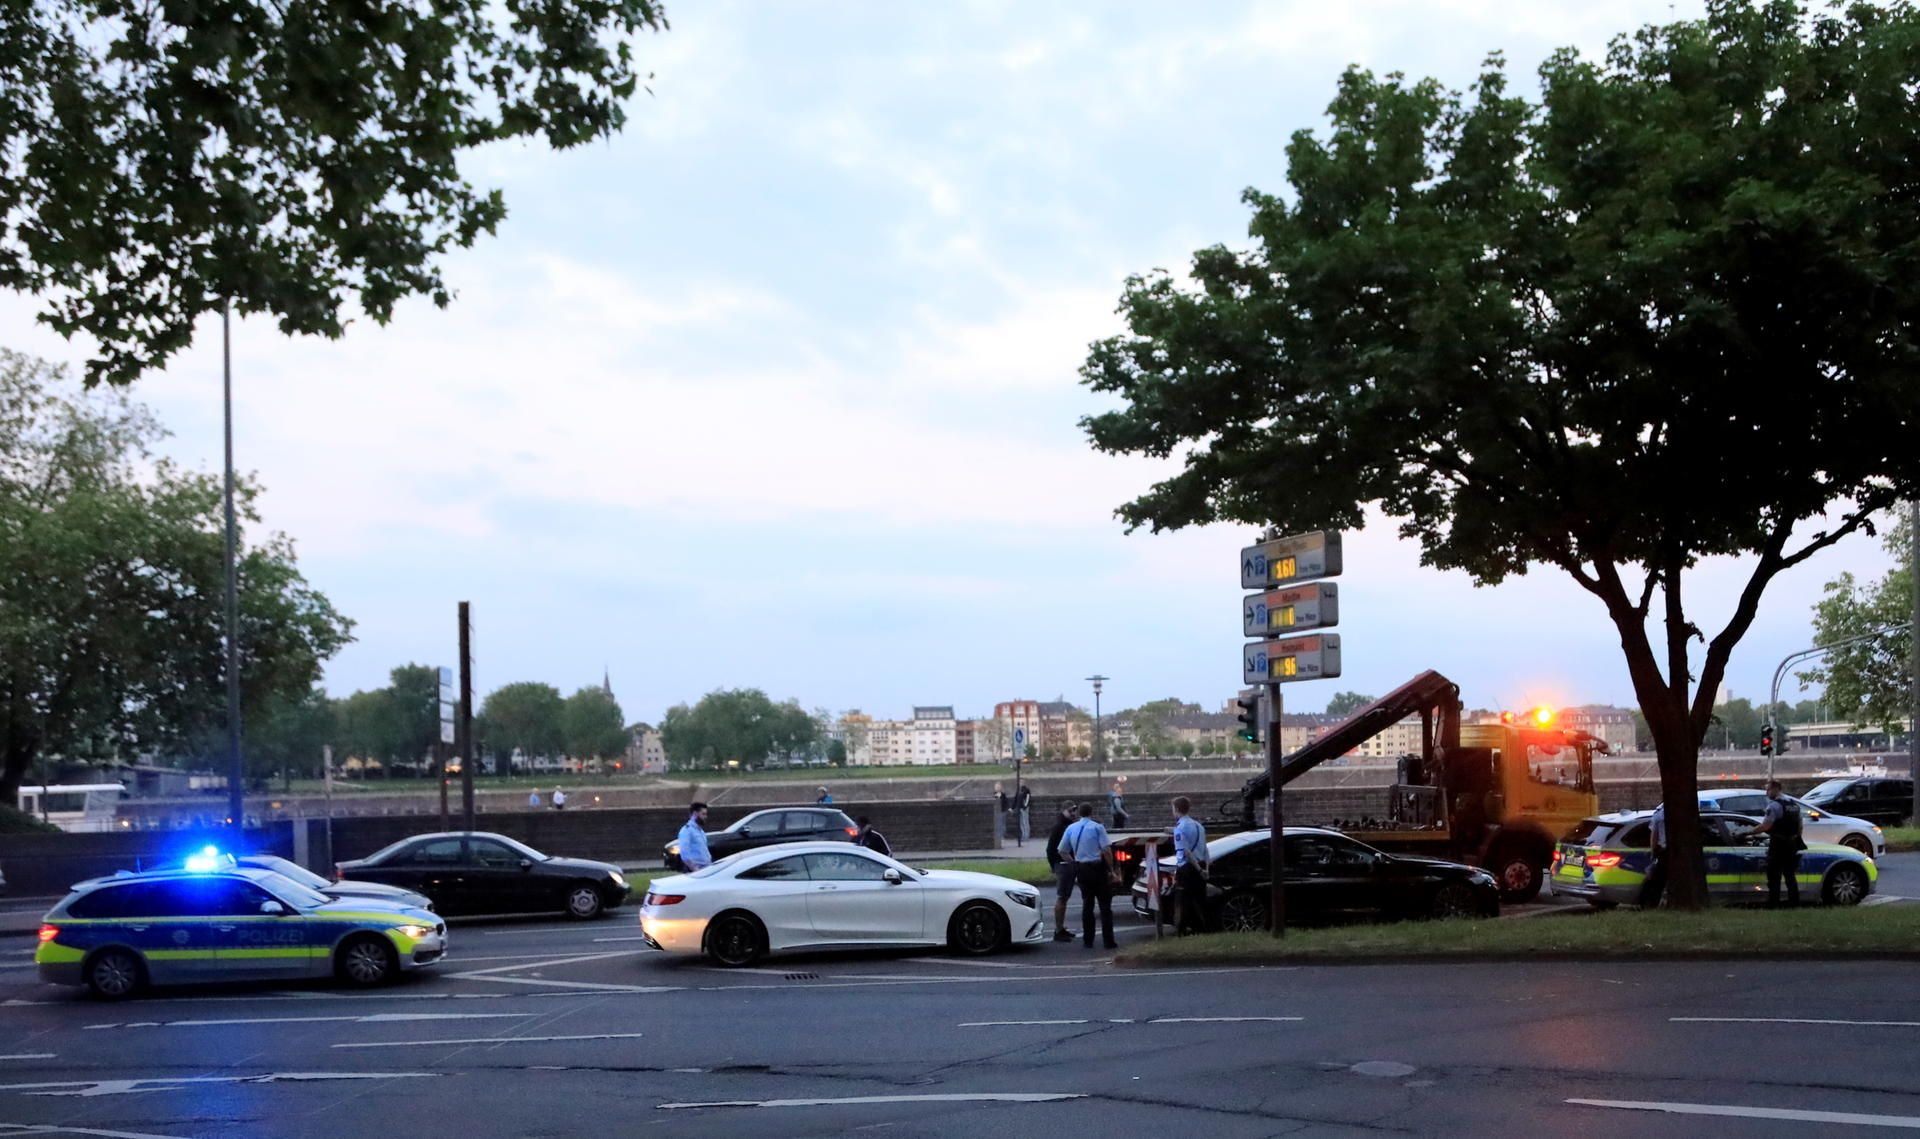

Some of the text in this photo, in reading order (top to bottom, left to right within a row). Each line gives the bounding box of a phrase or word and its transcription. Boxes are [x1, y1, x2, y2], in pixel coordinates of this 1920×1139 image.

[1275, 557, 1295, 579] 160
[1284, 657, 1296, 676] 96
[238, 929, 304, 943] POLIZEI
